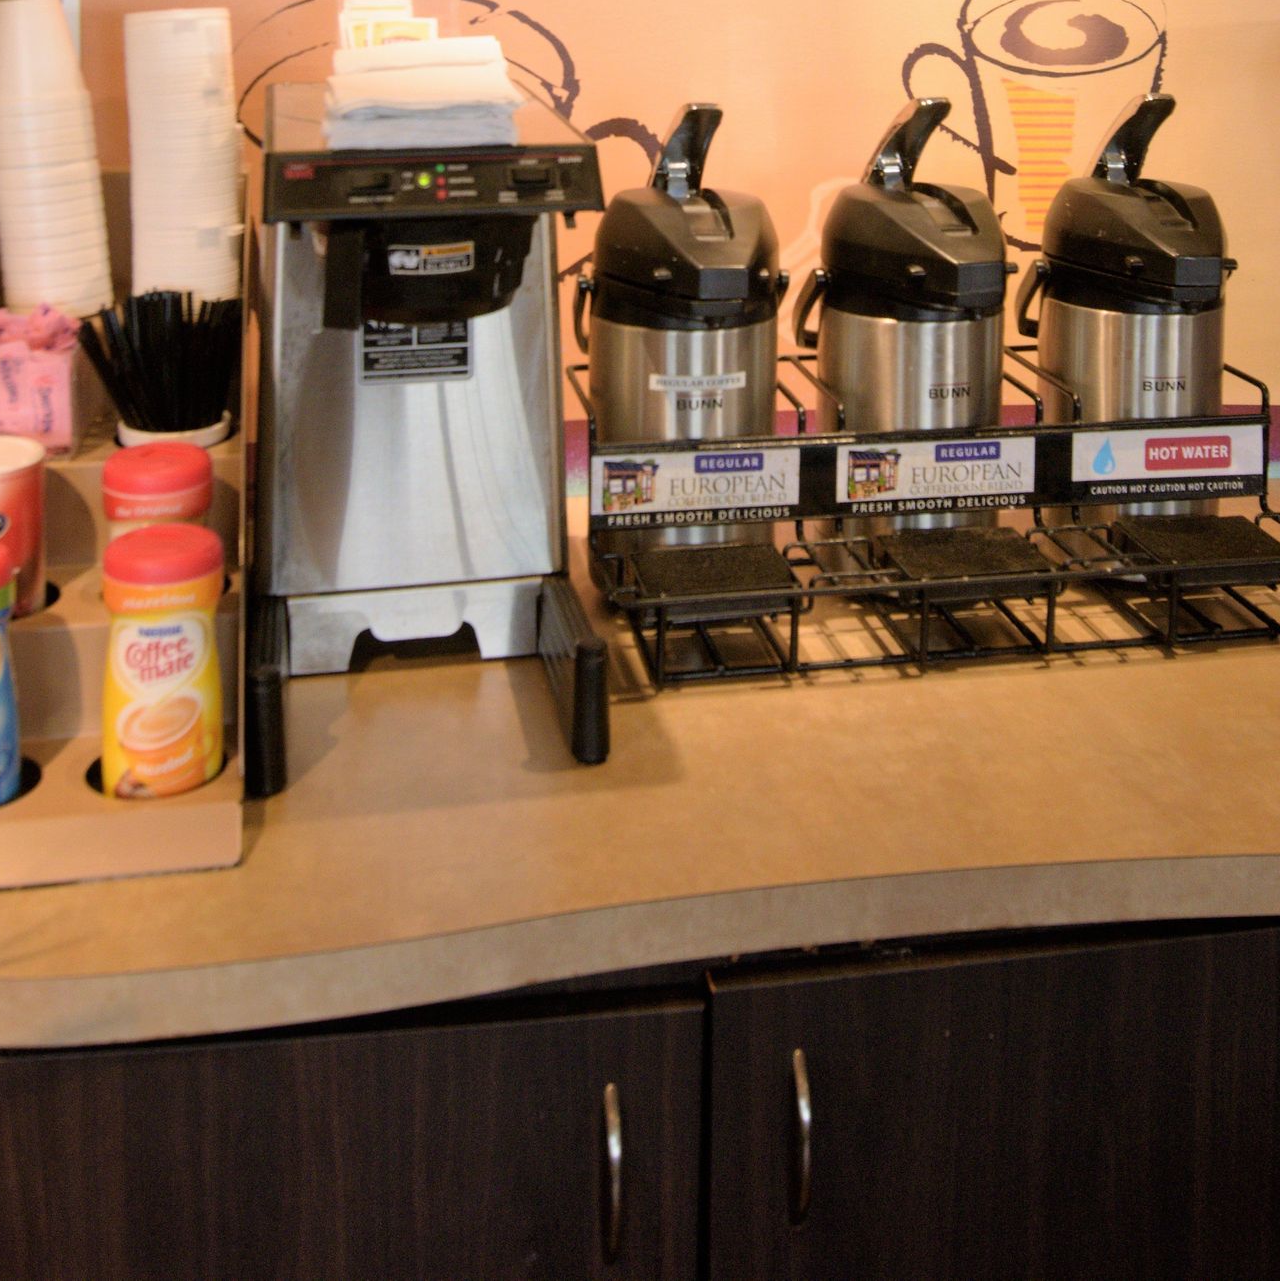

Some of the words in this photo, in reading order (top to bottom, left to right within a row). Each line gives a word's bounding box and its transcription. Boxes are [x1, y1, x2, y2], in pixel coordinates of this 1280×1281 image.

[928, 385, 971, 400] BUNN
[1143, 379, 1186, 391] BUNN
[676, 398, 723, 411] BUNN
[940, 445, 997, 458] REGULAR
[1149, 447, 1179, 460] HOT
[1181, 445, 1229, 459] WATER
[699, 457, 760, 469] REGULAR
[911, 461, 1023, 485] EUROPEAN
[670, 473, 787, 497] EUROPEAN
[987, 479, 1024, 492] BLEND
[1090, 485, 1128, 495] CAUTION
[1129, 484, 1147, 494] HOT
[1149, 482, 1187, 493] CAUTION
[1187, 482, 1206, 492] HOT
[1207, 480, 1245, 493] CAUTION
[852, 501, 893, 514] FRESH
[898, 498, 953, 511] SMOOTH
[957, 494, 1027, 508] DELICIOUS
[607, 512, 651, 527] FRESH
[655, 509, 714, 525] SMOOTH
[718, 506, 791, 520] DELICIOUS
[124, 637, 190, 667] Coffee
